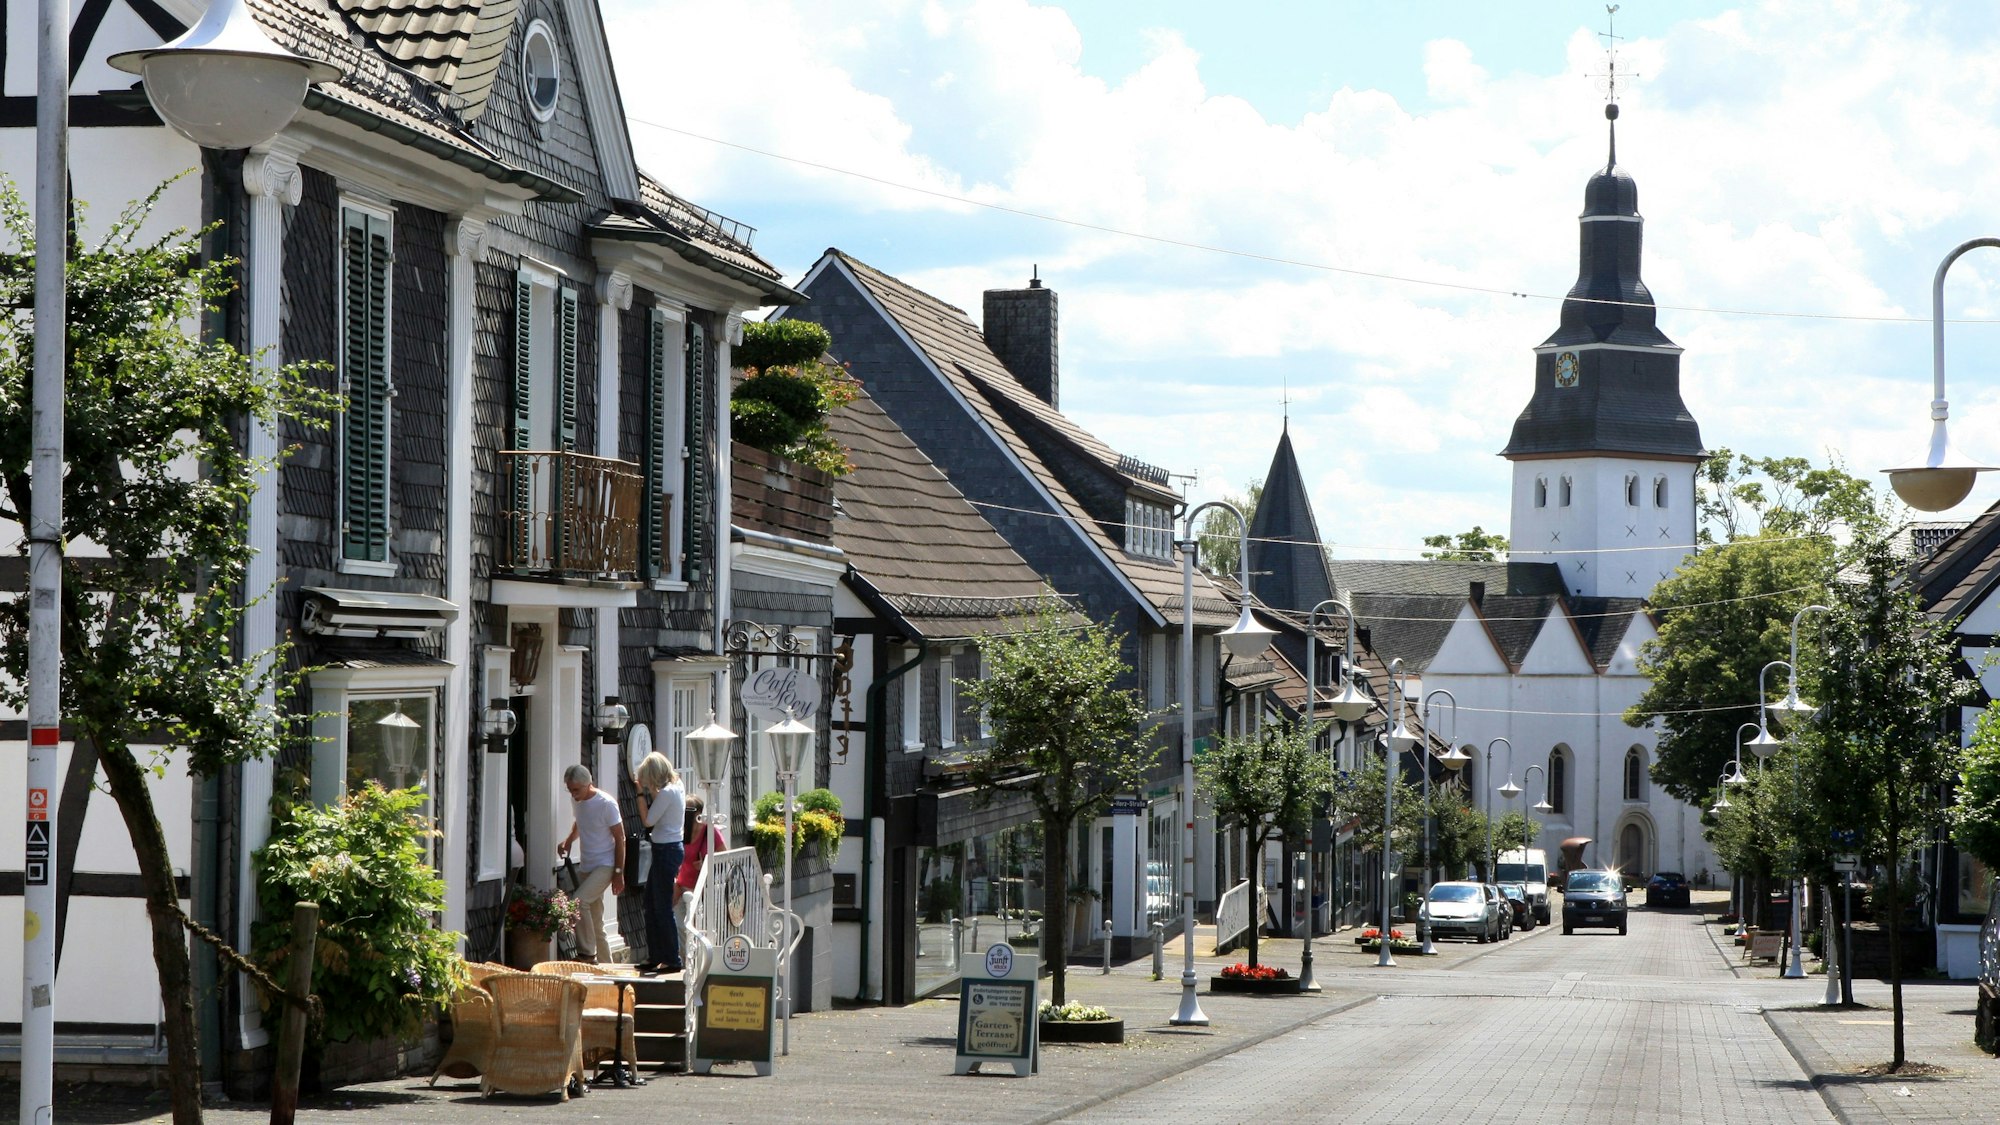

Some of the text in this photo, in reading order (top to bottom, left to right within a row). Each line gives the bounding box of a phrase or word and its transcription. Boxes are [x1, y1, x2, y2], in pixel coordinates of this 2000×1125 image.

[753, 669, 799, 701] Café
[975, 1020, 1012, 1030] Garten-
[975, 1029, 1015, 1039] Terrasse
